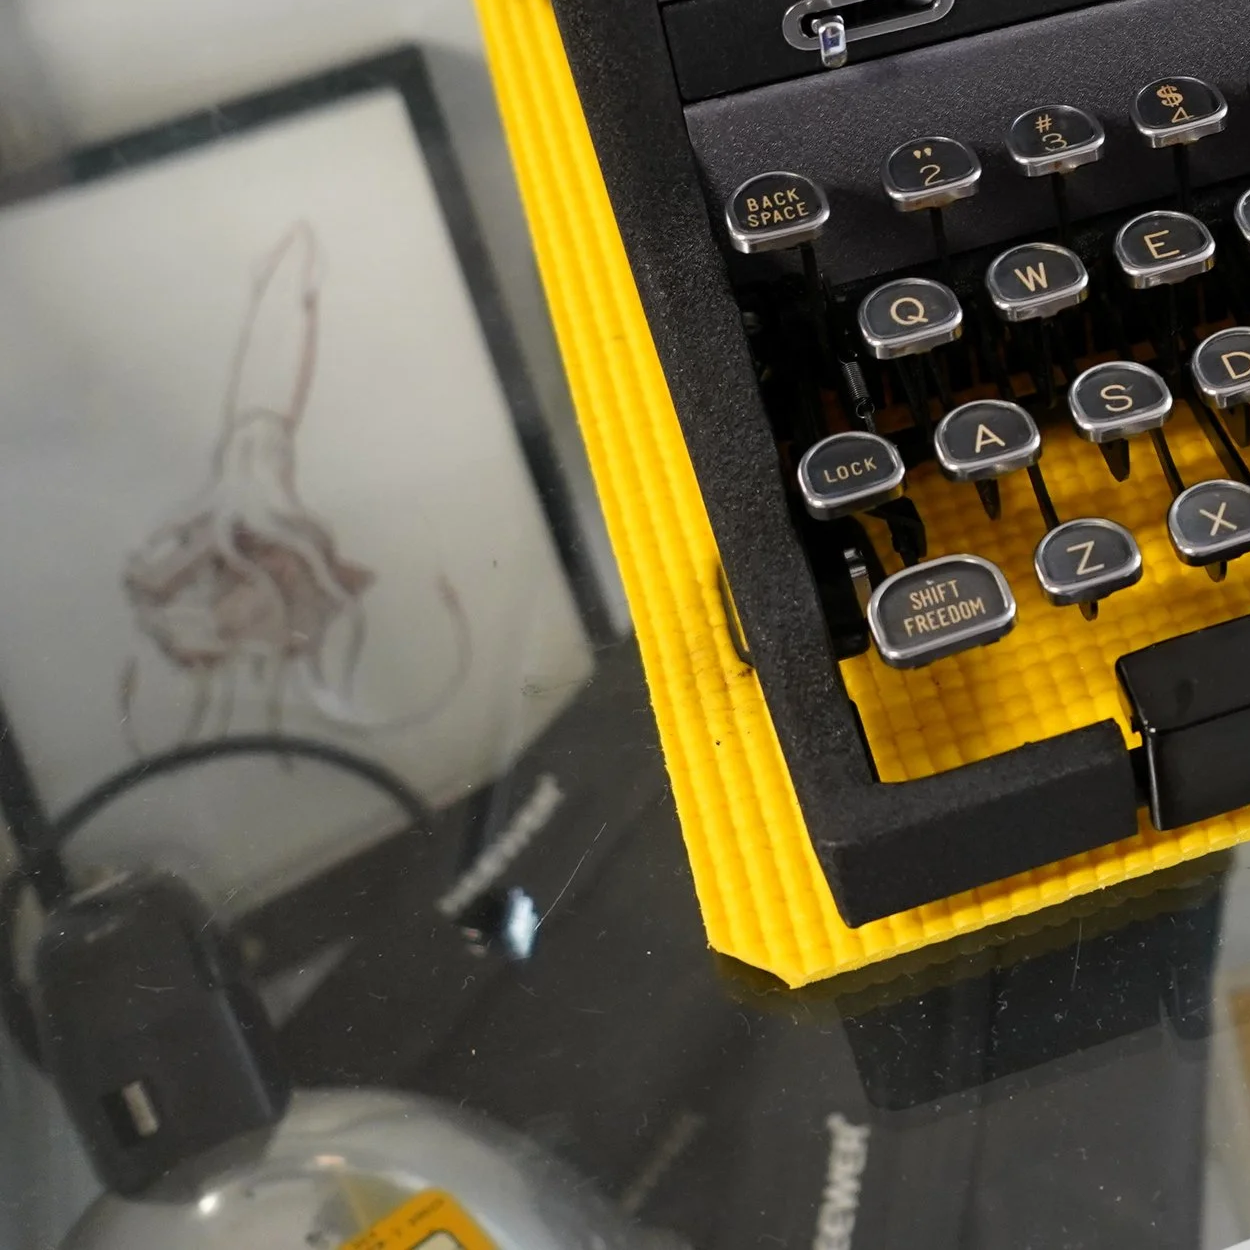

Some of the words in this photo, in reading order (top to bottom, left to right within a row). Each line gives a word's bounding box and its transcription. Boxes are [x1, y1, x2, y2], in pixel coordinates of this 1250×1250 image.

[1159, 84, 1183, 108] $
[1036, 114, 1053, 133] #
[1170, 106, 1195, 124] 4
[1043, 133, 1067, 150] 3
[919, 164, 941, 186] 2
[747, 187, 800, 213] BACK
[747, 202, 810, 228] SPACE
[1144, 230, 1180, 260] E
[1014, 262, 1048, 292] W
[890, 296, 928, 326] Q
[1100, 384, 1133, 412] S
[975, 424, 1007, 453] A
[823, 457, 877, 484] LOCK
[1198, 501, 1240, 537] X
[1067, 540, 1105, 575] Z
[909, 579, 960, 611] SHIFT
[903, 596, 987, 638] FREEDOM
